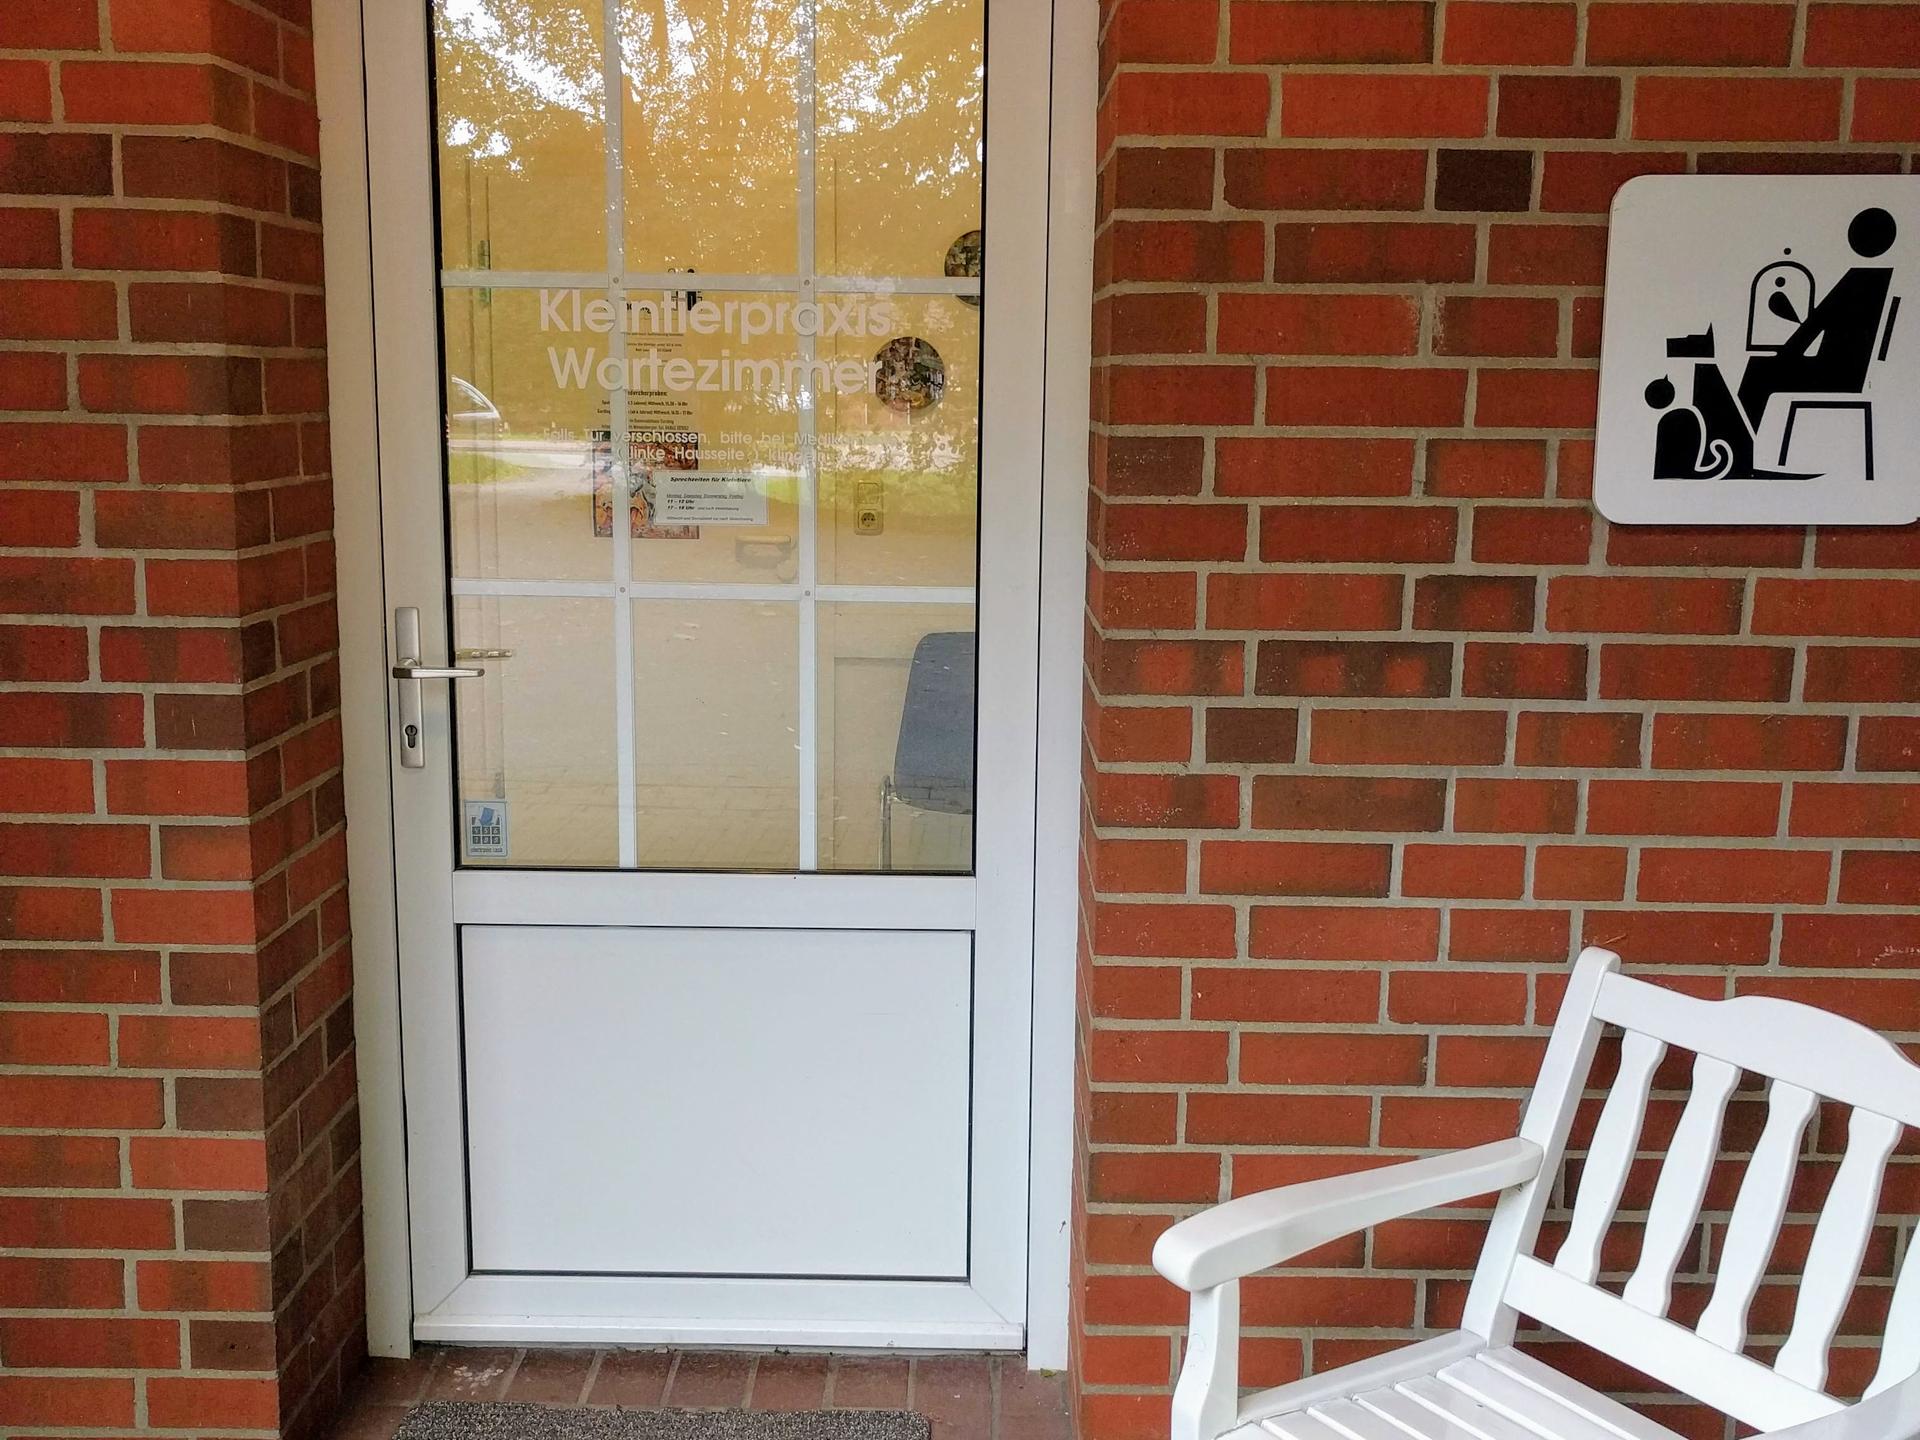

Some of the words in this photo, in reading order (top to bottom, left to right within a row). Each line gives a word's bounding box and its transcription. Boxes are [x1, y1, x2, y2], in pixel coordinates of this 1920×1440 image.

[540, 288, 892, 344] Kleintierpraxis
[547, 346, 883, 394] Wartezimmer
[720, 431, 753, 445] bitte
[761, 431, 785, 445] bei
